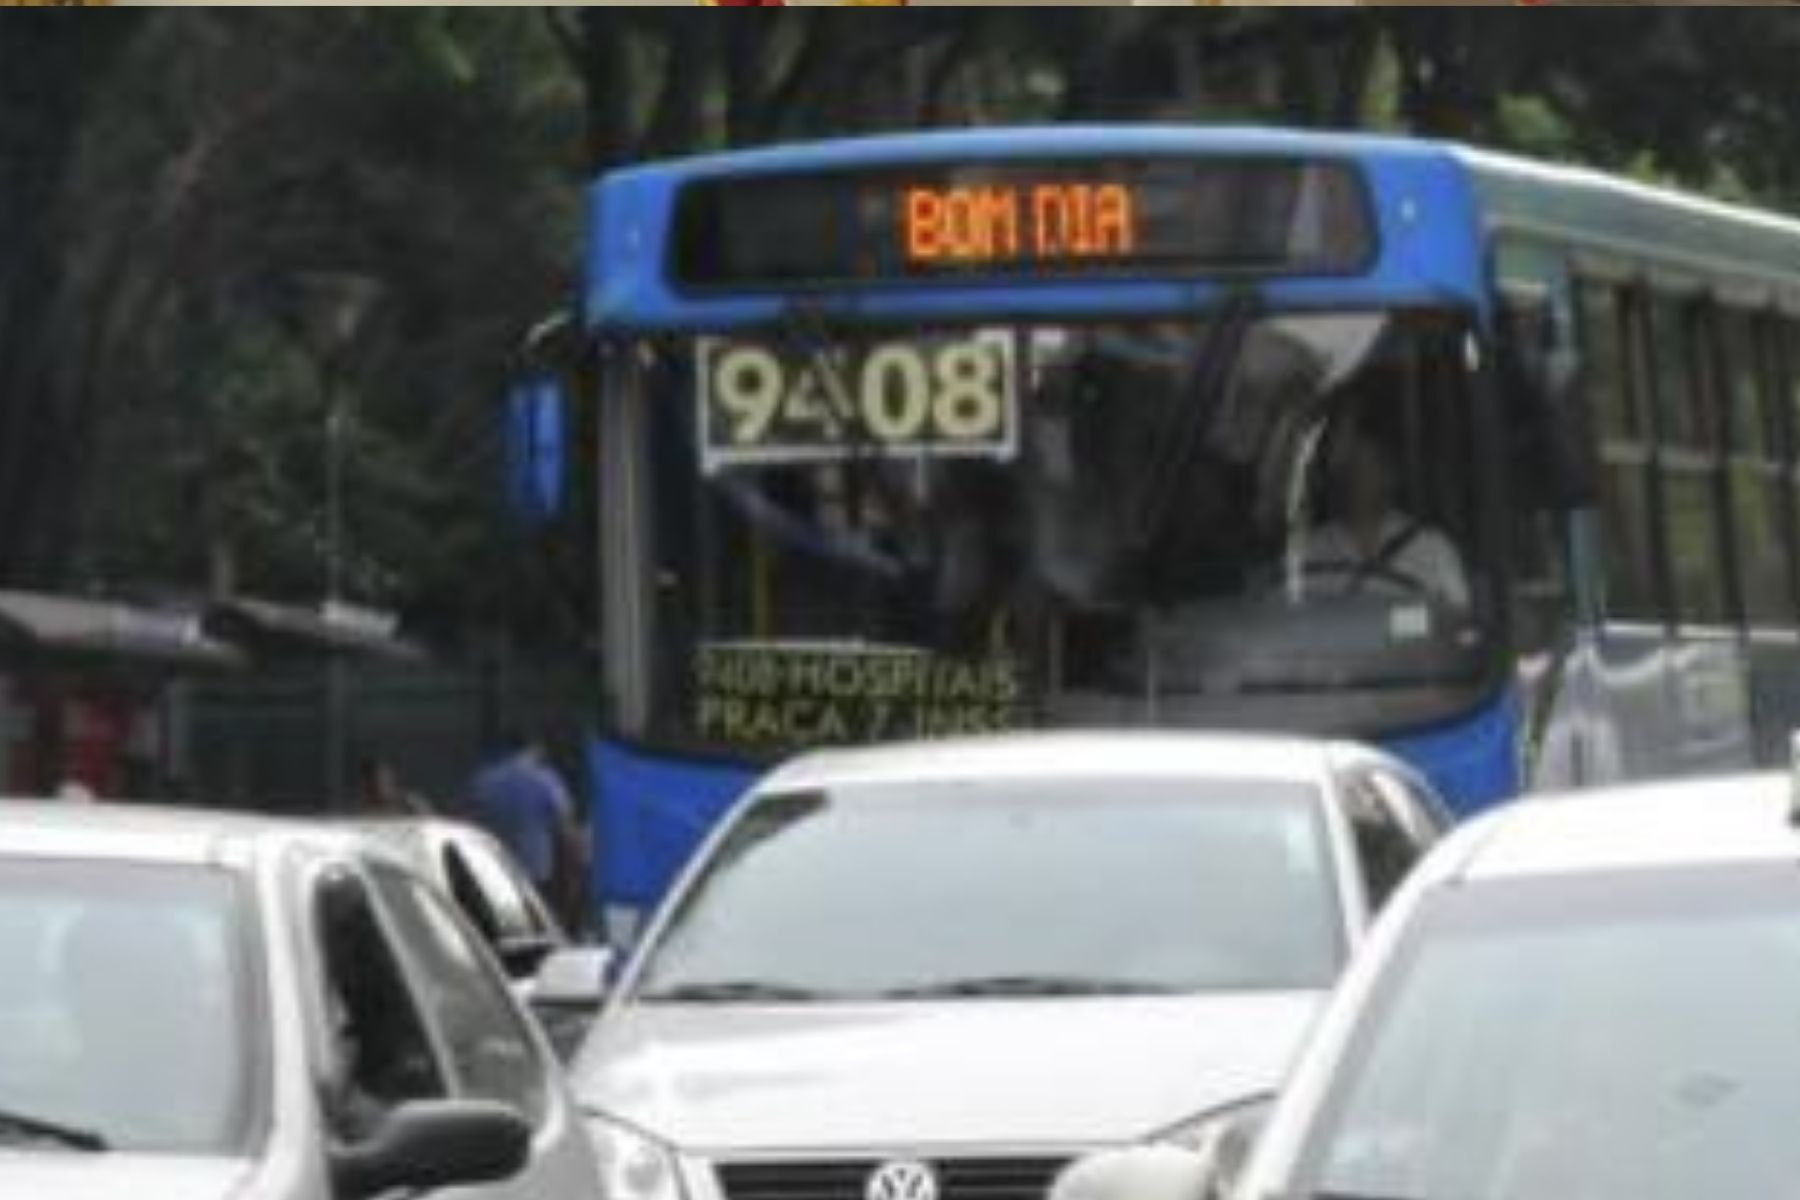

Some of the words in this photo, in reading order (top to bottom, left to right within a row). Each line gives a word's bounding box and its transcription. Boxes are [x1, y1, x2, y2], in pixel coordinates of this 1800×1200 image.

[907, 184, 1017, 260] BOM
[1034, 182, 1134, 256] DIA
[715, 344, 1001, 442] 9408
